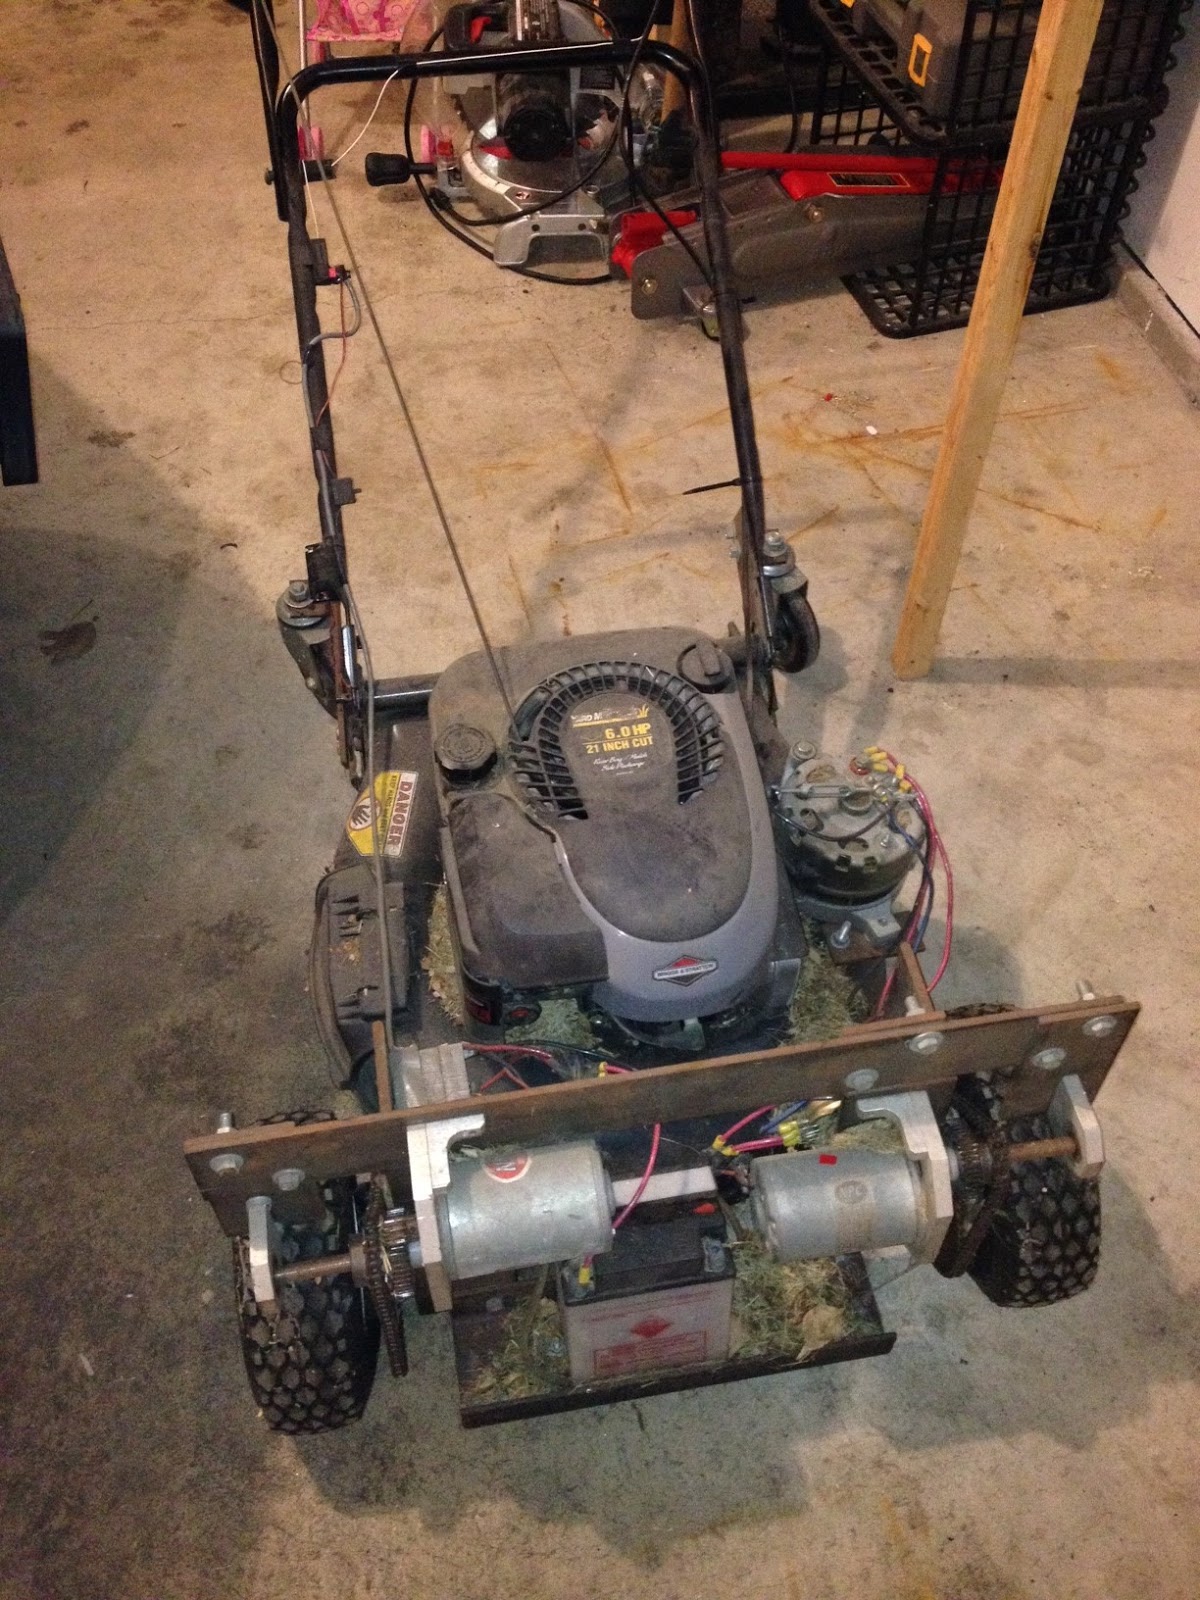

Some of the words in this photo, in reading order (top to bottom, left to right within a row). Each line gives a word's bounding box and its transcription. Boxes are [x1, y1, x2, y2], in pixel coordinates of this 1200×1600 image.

[605, 726, 631, 739] 6.0
[632, 723, 651, 735] HP
[586, 744, 600, 754] 21
[603, 742, 630, 752] INCH
[632, 736, 654, 747] CUT
[387, 781, 414, 845] DANGER
